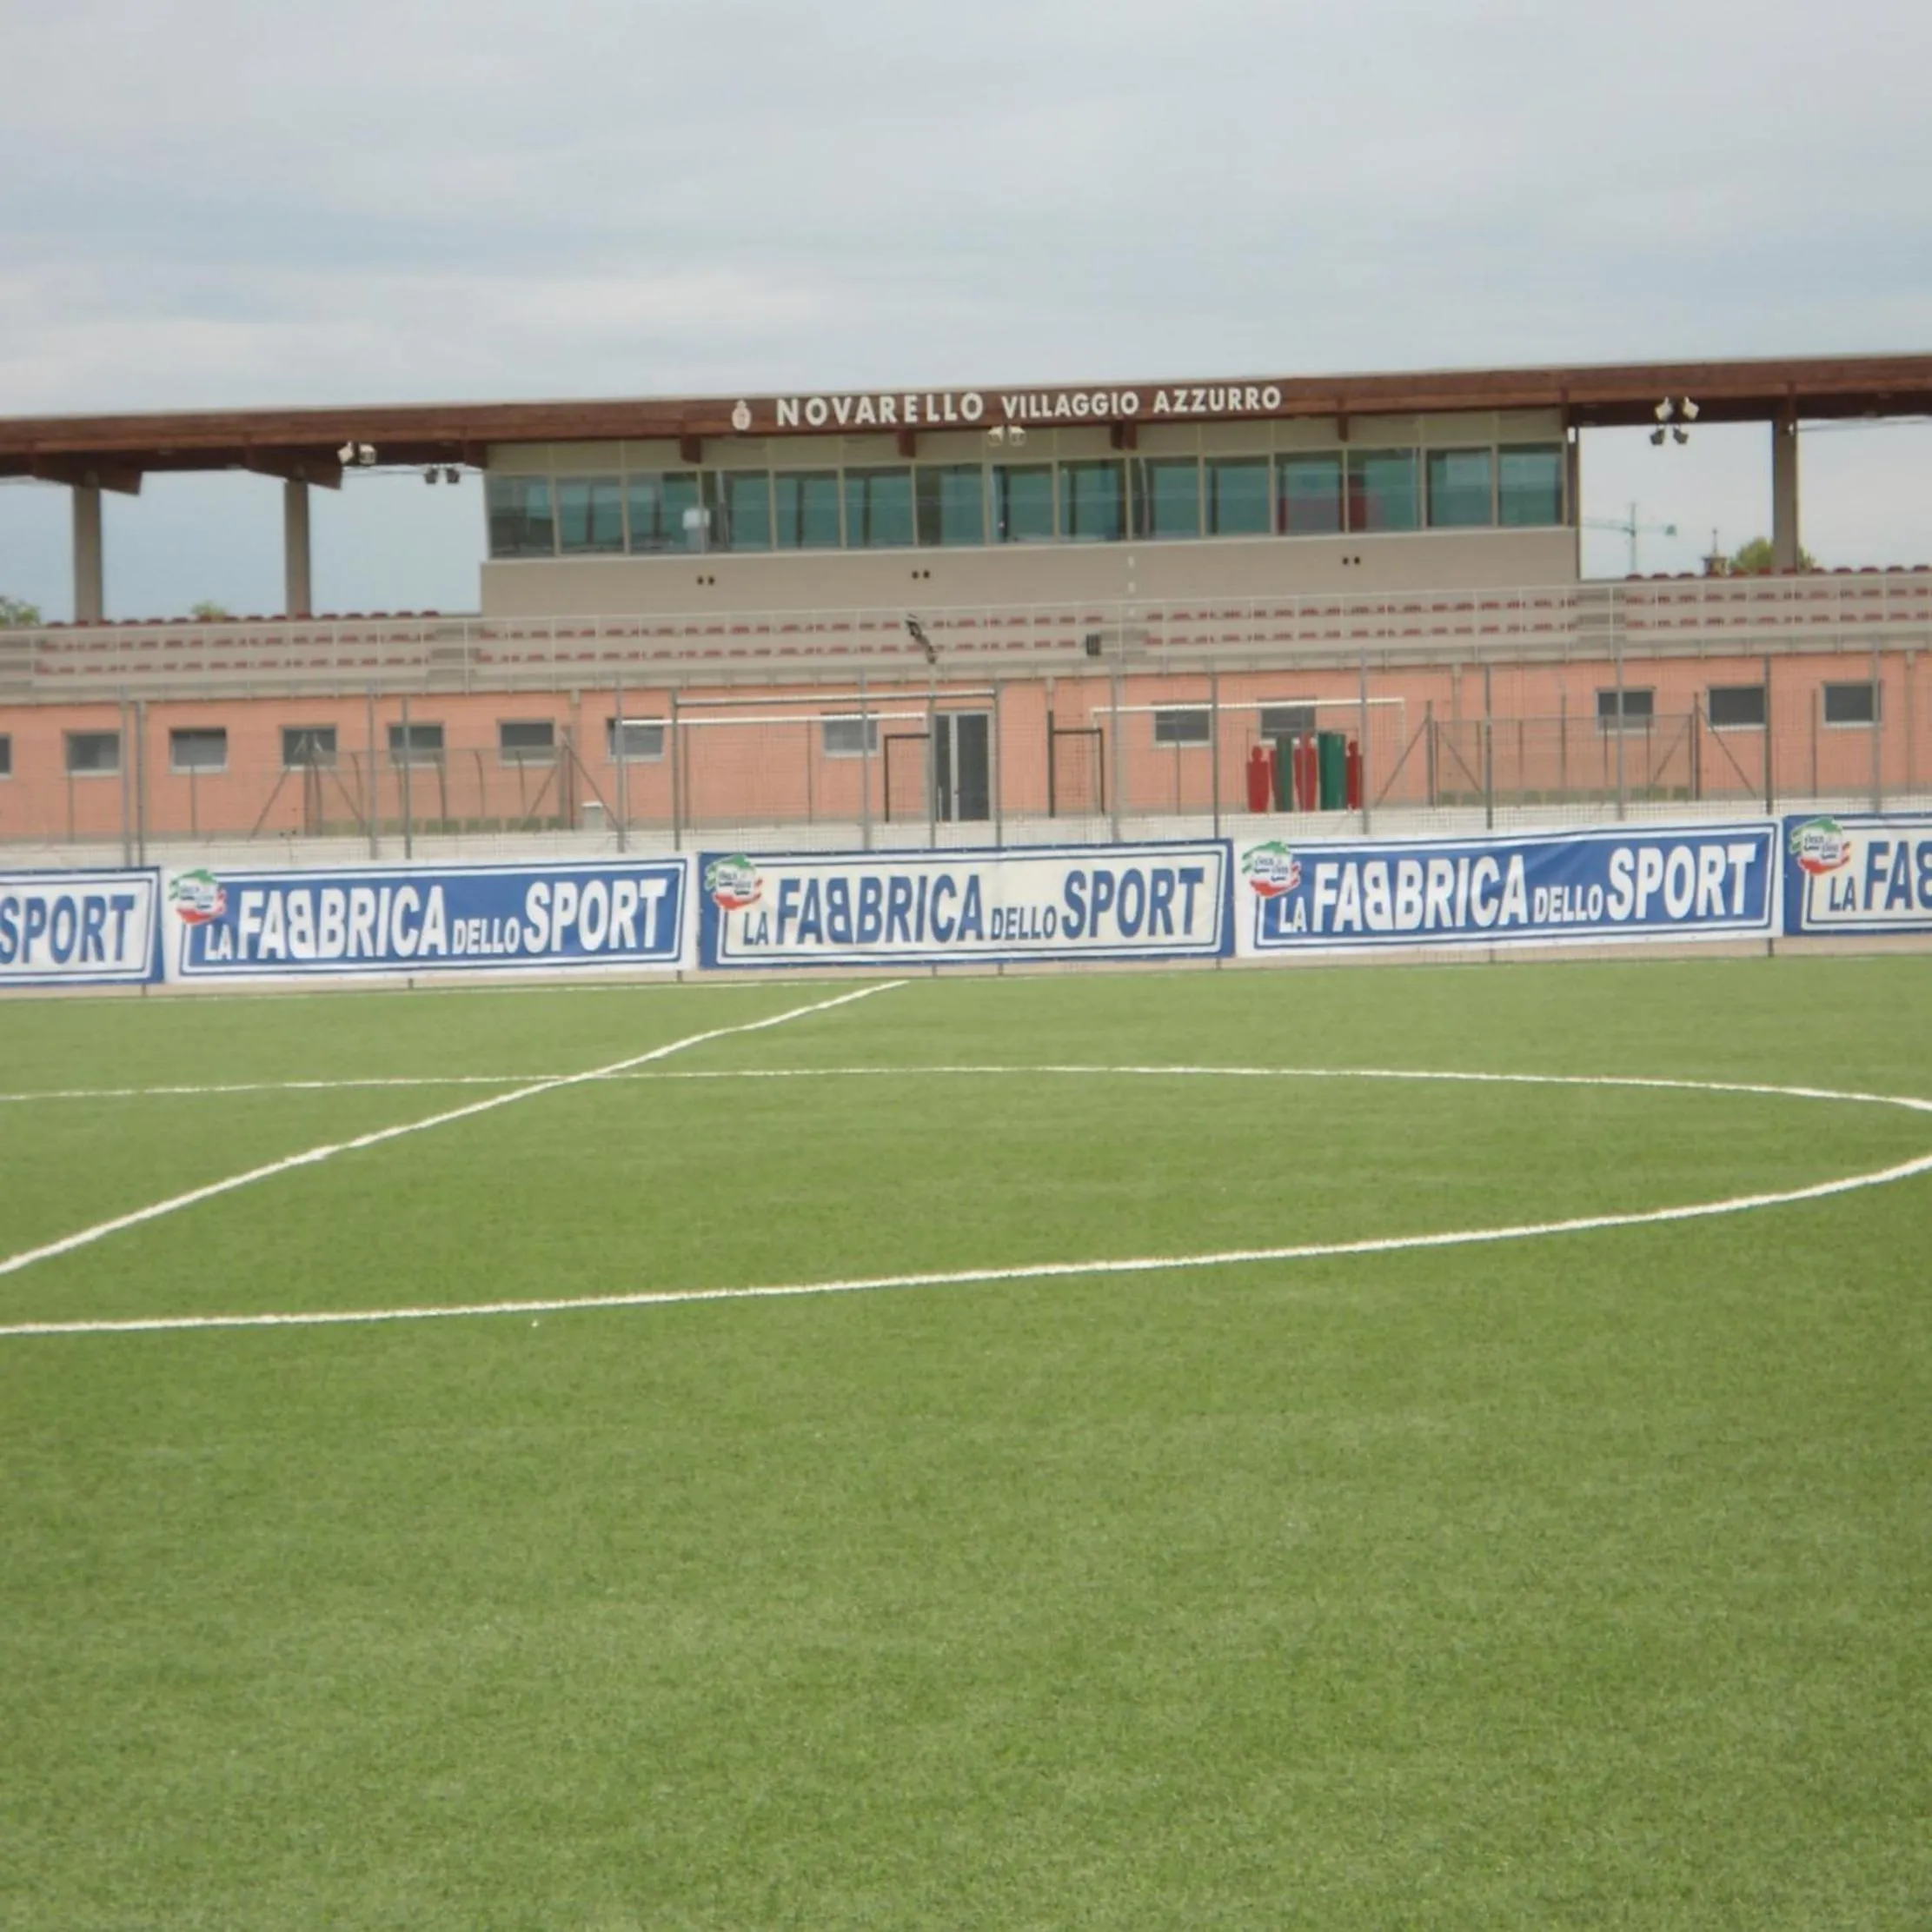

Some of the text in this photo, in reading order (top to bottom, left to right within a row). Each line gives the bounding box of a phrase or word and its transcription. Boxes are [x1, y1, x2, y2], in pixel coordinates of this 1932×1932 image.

[777, 386, 1281, 426] NOVARELLO VILLAGGIO AZZURRO
[204, 924, 233, 960] LA
[236, 885, 448, 959] FABBRICA
[453, 915, 520, 955] DELLO
[523, 879, 667, 953] SPORT
[743, 911, 769, 946] LA
[776, 874, 985, 946] FABBRICA
[991, 905, 1058, 941] DELLO
[1061, 867, 1205, 940] SPORT
[1278, 896, 1308, 933] LA
[1311, 853, 1527, 933] FABBRICA
[1533, 884, 1604, 923] DELLO
[1606, 844, 1757, 921] SPORT
[1829, 875, 1856, 912] LA
[0, 894, 135, 965] SPORT
